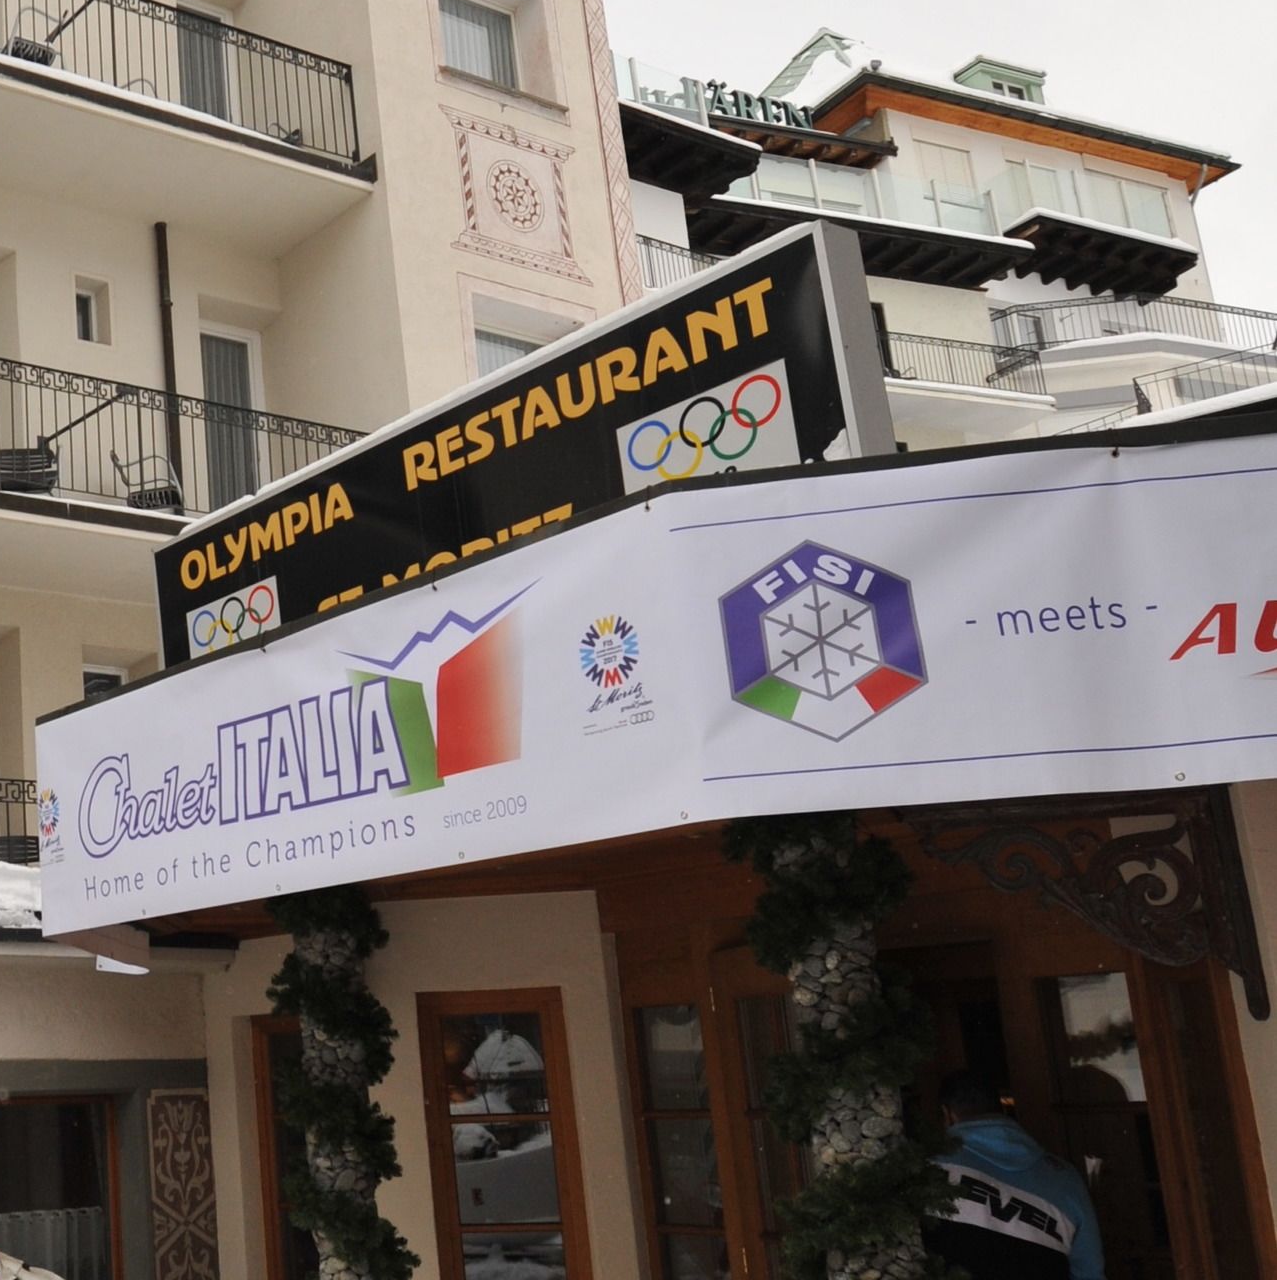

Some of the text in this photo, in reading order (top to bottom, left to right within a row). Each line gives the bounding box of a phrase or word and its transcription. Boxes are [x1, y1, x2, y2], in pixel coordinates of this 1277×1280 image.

[180, 483, 354, 590] OLYMPIA
[403, 277, 773, 491] RESTAURANT
[752, 554, 875, 604] FISI
[996, 597, 1127, 637] meets
[217, 676, 411, 826] ITALIA
[442, 794, 528, 829] since 2009
[85, 814, 416, 901] Home of the Champions
